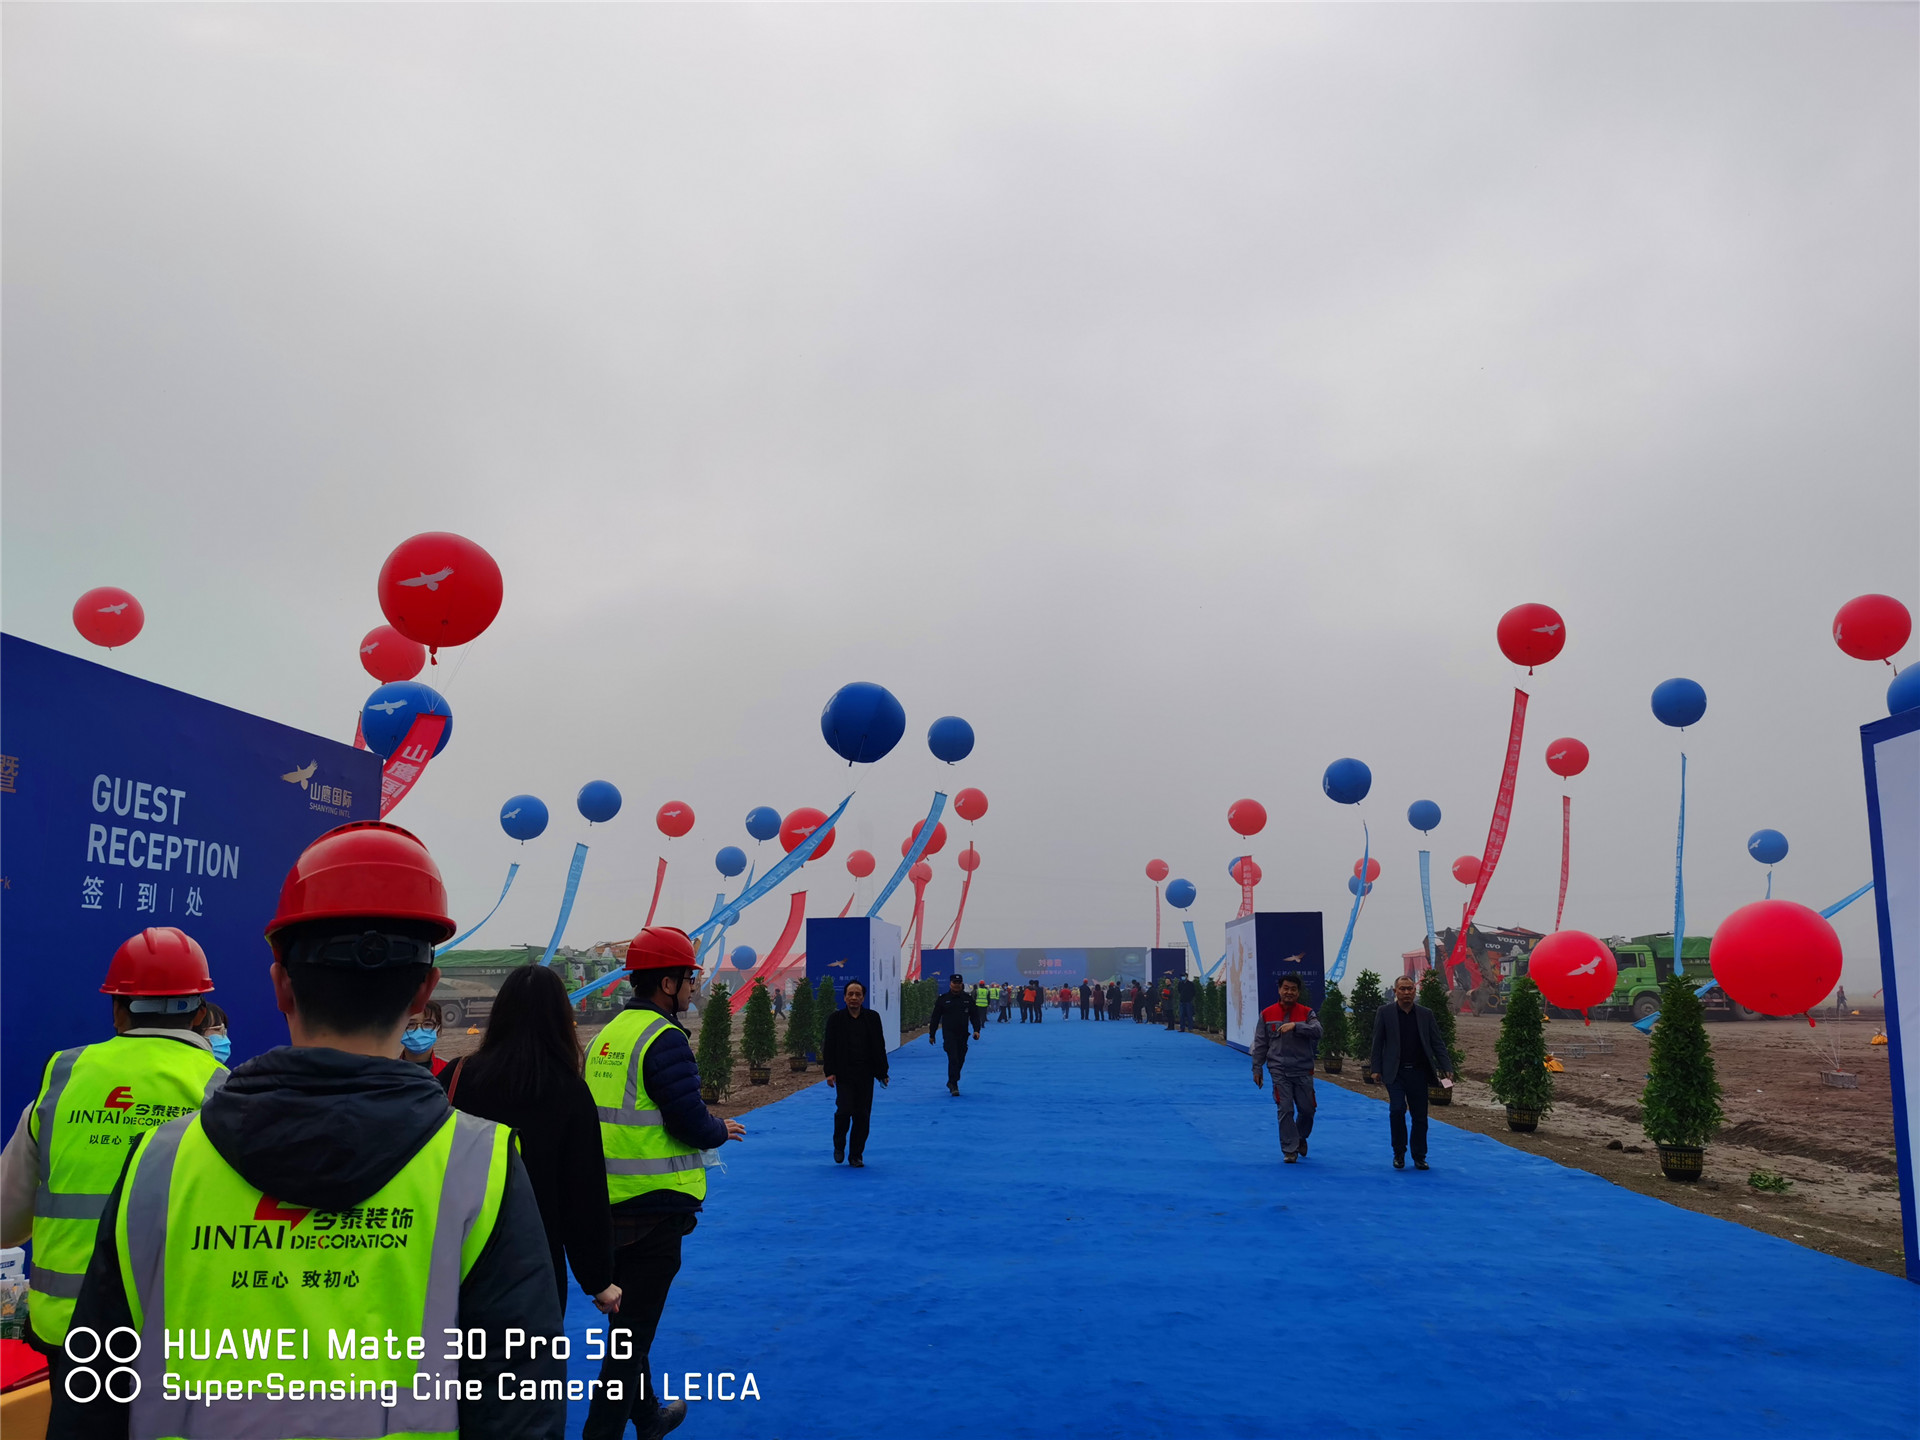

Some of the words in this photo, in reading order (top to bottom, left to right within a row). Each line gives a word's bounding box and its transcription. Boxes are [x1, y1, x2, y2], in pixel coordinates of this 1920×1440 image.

[92, 773, 186, 826] GUEST
[310, 782, 353, 808] 山鹰国际
[309, 802, 338, 816] SHANYING
[86, 823, 240, 880] RECEPTION
[1496, 936, 1526, 945] VOLVO
[67, 1110, 120, 1124] JINTAI
[89, 1134, 122, 1145] 以匠心
[313, 1207, 414, 1231] 今泰装饰
[191, 1225, 285, 1250] JINTAI
[290, 1233, 408, 1250] DECORATION
[231, 1270, 289, 1288] 以匠心
[301, 1269, 360, 1288] 致初心
